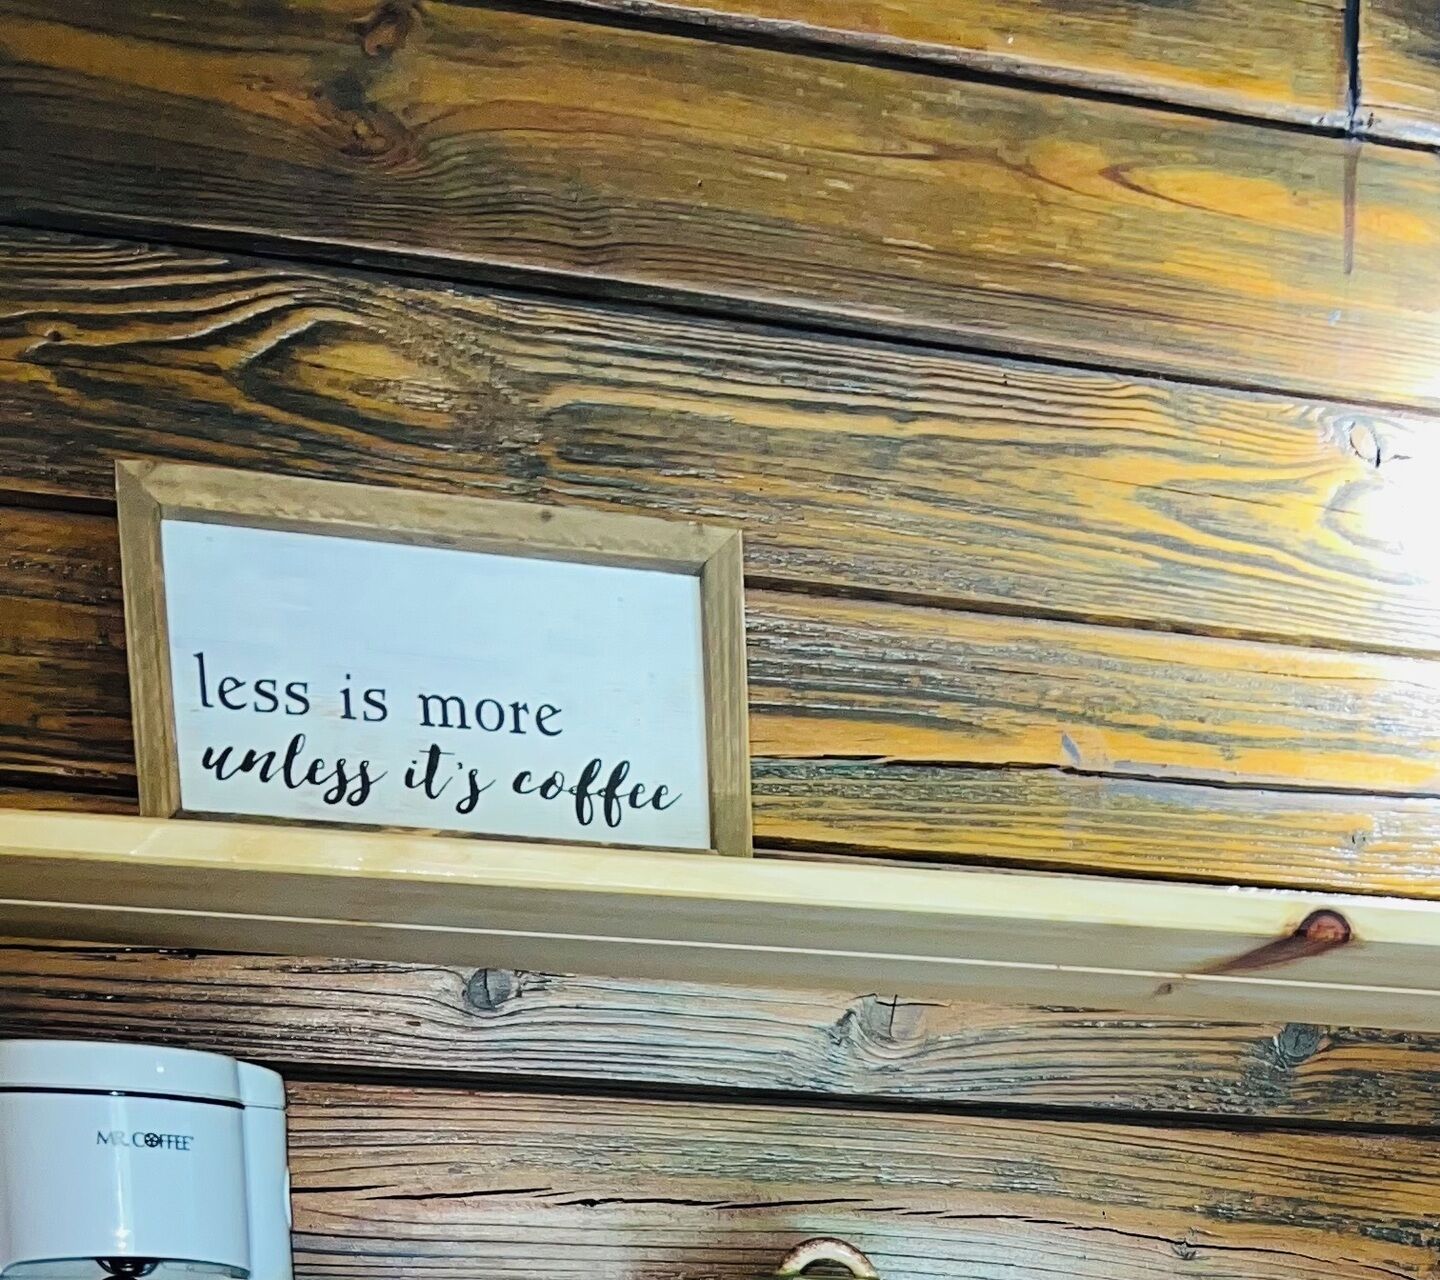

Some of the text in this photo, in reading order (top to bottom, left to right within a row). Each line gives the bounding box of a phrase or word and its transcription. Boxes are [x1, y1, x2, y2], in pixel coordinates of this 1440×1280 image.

[193, 652, 563, 736] less is more
[202, 733, 681, 828] unless it's coffee
